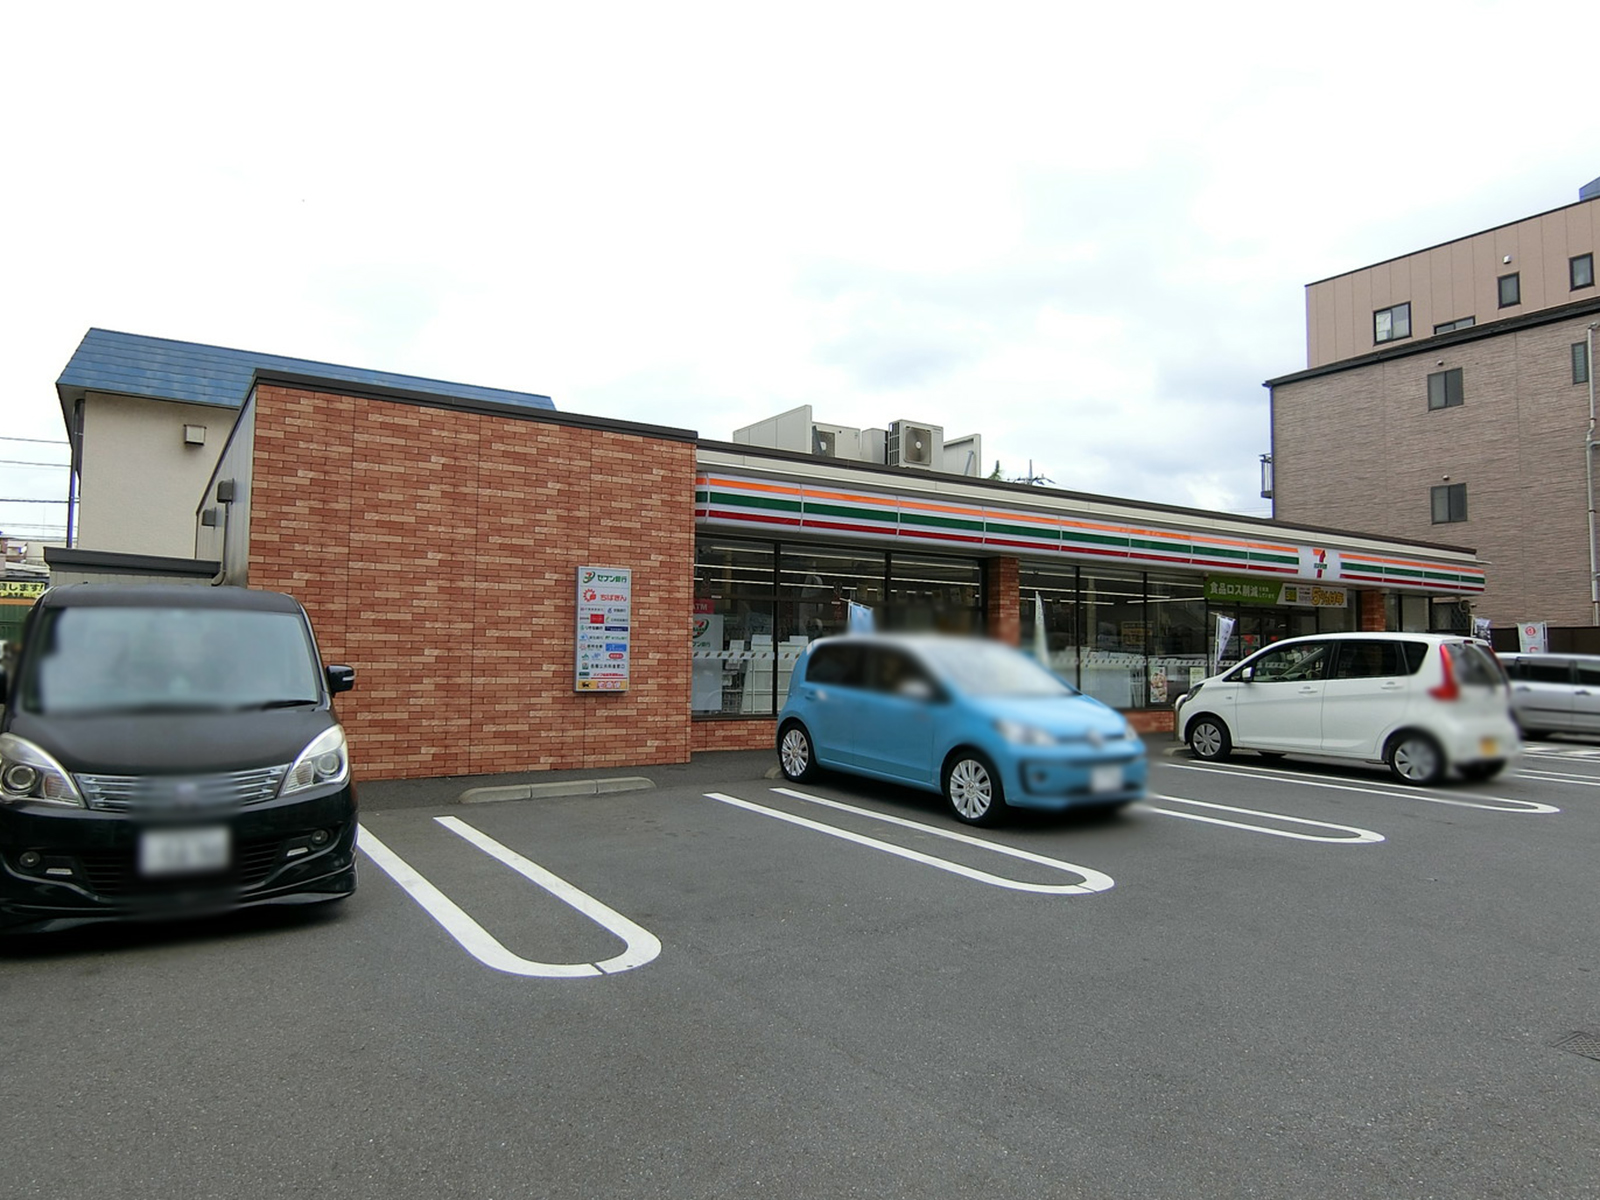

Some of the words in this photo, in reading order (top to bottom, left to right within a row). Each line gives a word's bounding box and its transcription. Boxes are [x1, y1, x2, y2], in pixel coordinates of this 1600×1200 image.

[1210, 581, 1258, 597] 食品ロス削減
